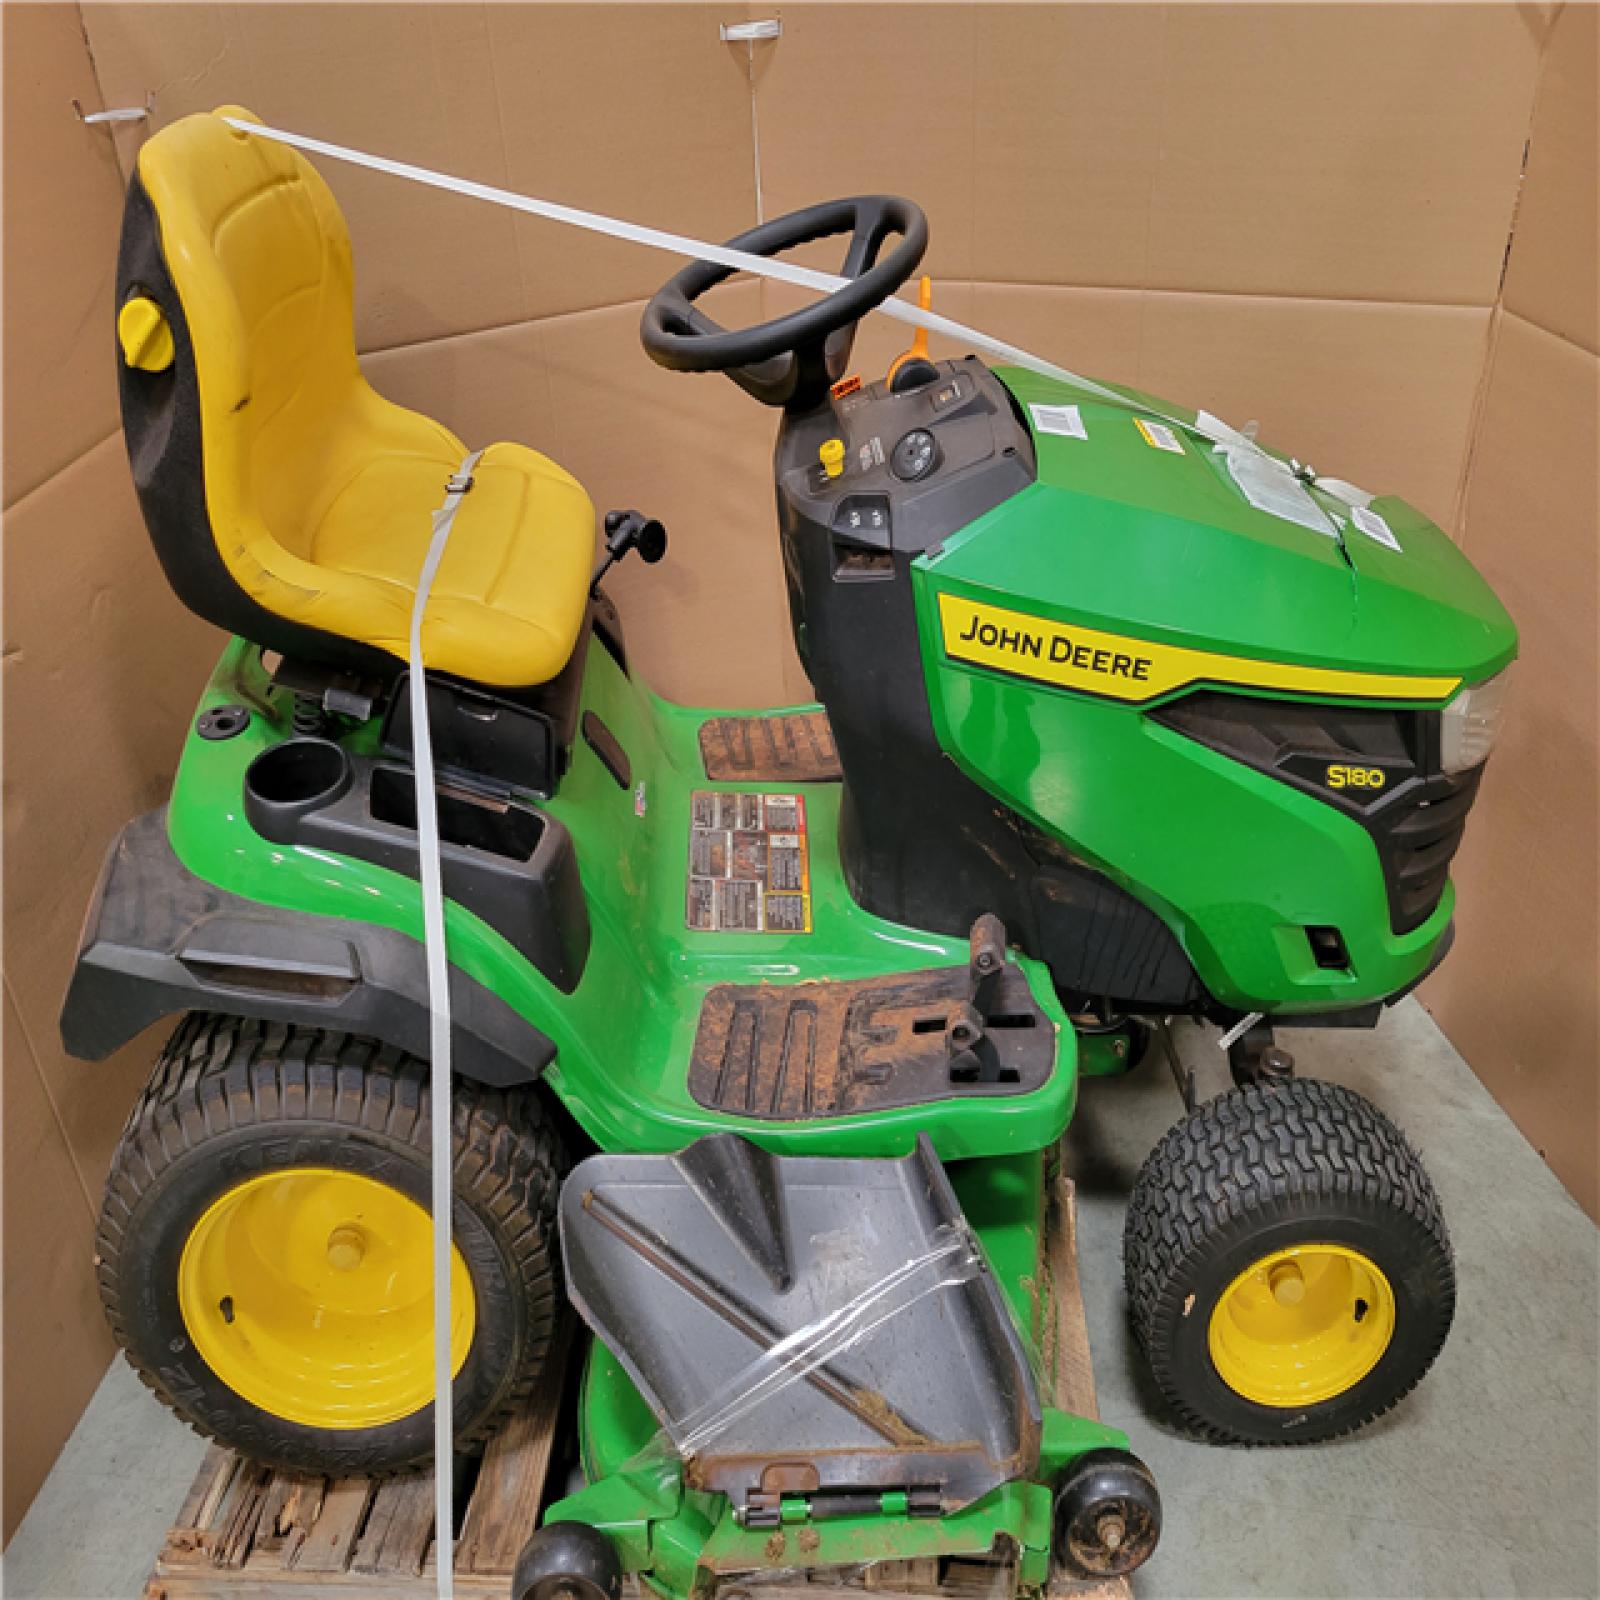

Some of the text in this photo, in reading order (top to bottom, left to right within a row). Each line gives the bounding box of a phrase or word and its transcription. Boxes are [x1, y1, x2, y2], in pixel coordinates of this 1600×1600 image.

[960, 615, 1153, 681] JOHN DEERE
[1327, 764, 1385, 789] S180
